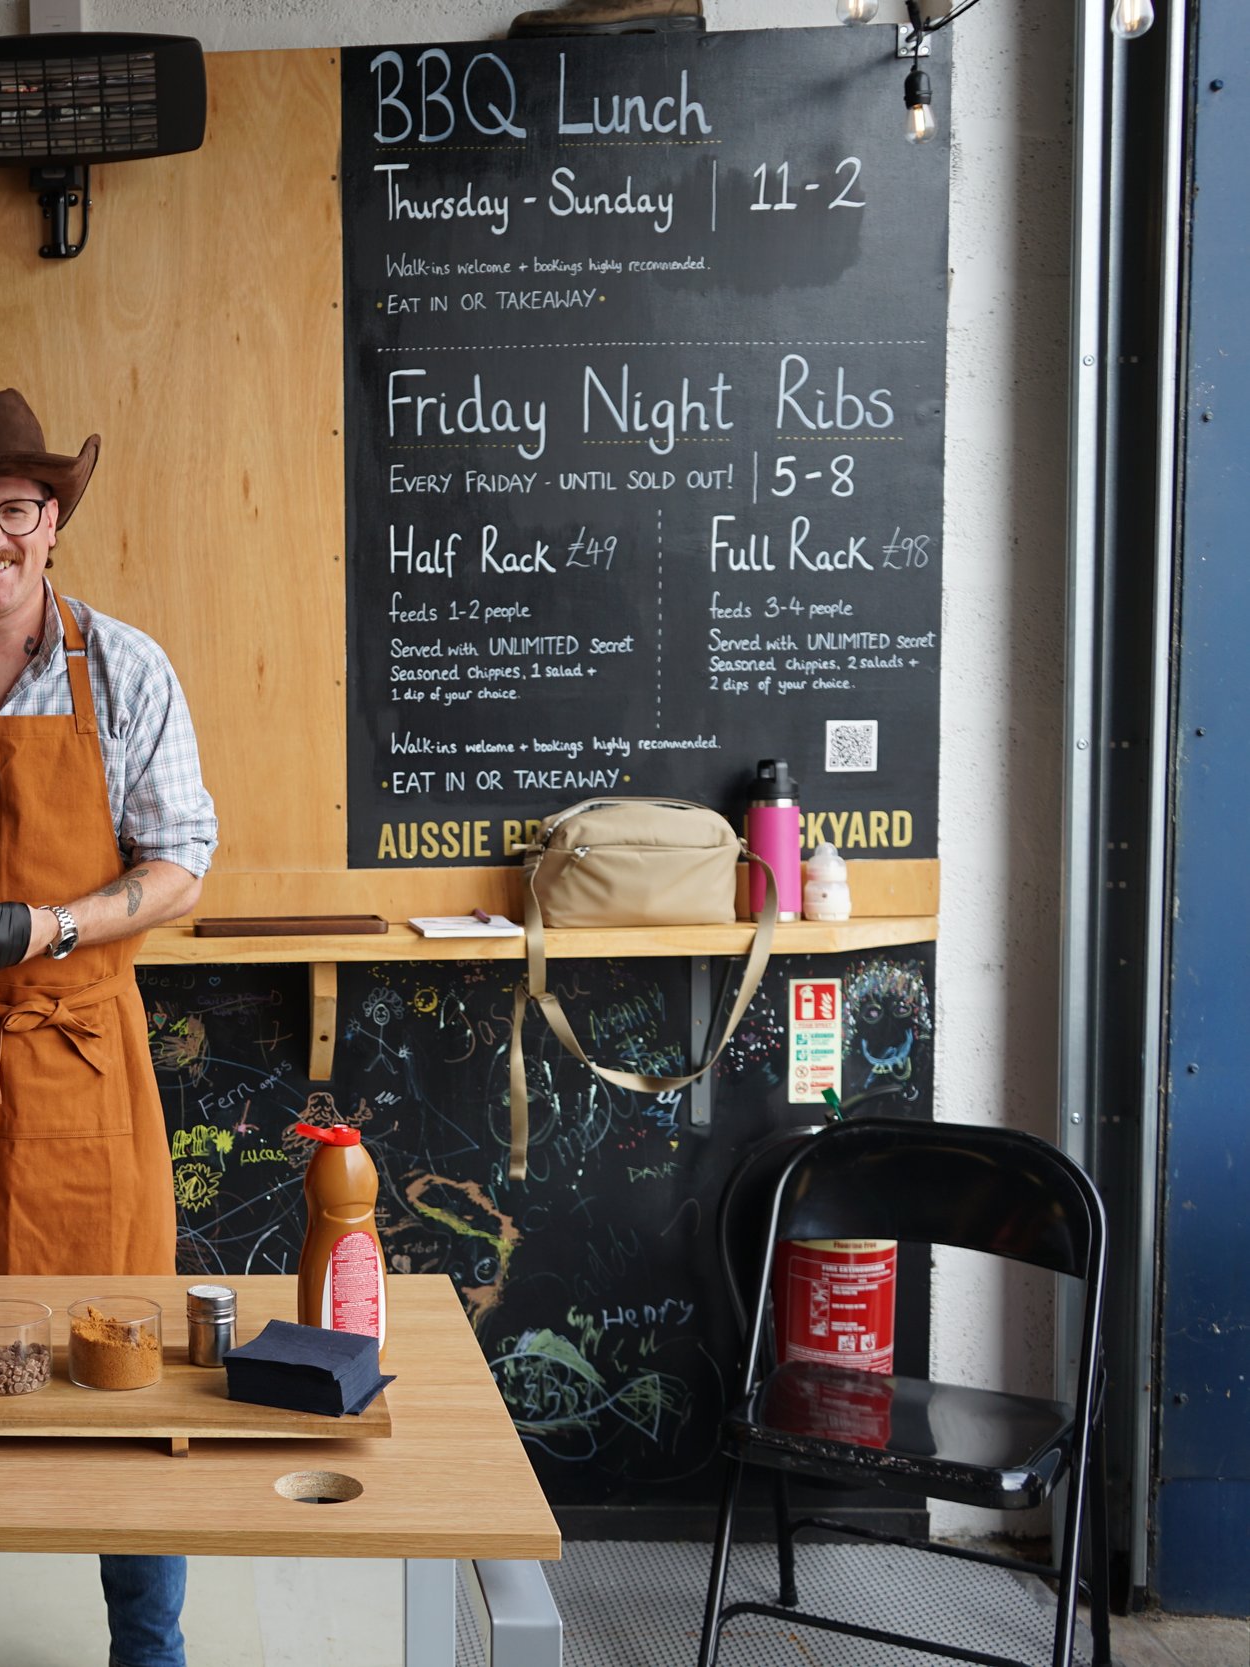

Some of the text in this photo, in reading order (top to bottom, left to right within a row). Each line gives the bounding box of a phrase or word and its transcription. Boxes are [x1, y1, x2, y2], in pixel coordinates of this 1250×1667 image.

[370, 48, 712, 144] BBQ Lunch
[373, 163, 510, 235] Thursday
[549, 166, 675, 233] Sunday
[387, 253, 451, 277] Walk-ins
[458, 259, 511, 275] welcome
[534, 256, 583, 276] bookings
[589, 255, 622, 275] highly
[387, 288, 598, 315] EAT IN OR TAKEAWAY
[387, 353, 895, 460] Friday Night Ribs
[389, 464, 453, 493] EVERY
[465, 470, 538, 493] FRIDAY
[559, 471, 617, 491] UNTIL
[626, 470, 676, 490] SOLD
[686, 464, 733, 490] OUT!
[770, 455, 856, 497] 5-8
[389, 524, 618, 578] Half Rack £49
[710, 515, 932, 572] Full Rack £98
[388, 590, 532, 624] feeds 1-2 people
[709, 590, 854, 620] feeds 3-4 people
[390, 637, 443, 659] Served
[448, 641, 480, 657] with
[489, 635, 580, 656] UNLIMITED
[708, 627, 762, 652] Served
[766, 634, 799, 651] with
[807, 632, 890, 650] UNLIMITED
[390, 663, 461, 683] Seasoned
[531, 662, 541, 679] 1
[545, 663, 584, 678] salad
[708, 655, 777, 673] Seasoned
[847, 656, 858, 670] 2
[860, 654, 904, 668] salads
[391, 687, 401, 702] 1
[403, 687, 426, 703] dip
[430, 686, 442, 702] of
[443, 689, 473, 707] your
[709, 676, 719, 692] 2
[723, 676, 750, 696] dips
[758, 676, 772, 696] of
[778, 679, 807, 696] your
[390, 731, 457, 756] Walk-ins
[465, 739, 515, 755] welcome
[533, 737, 584, 760] bookings
[592, 736, 630, 757] highly
[392, 767, 620, 794] EAT IN OR TAKEAWAY
[377, 820, 491, 860] AUSSIE
[197, 1082, 256, 1121] Fern
[602, 1298, 694, 1331] Henry
